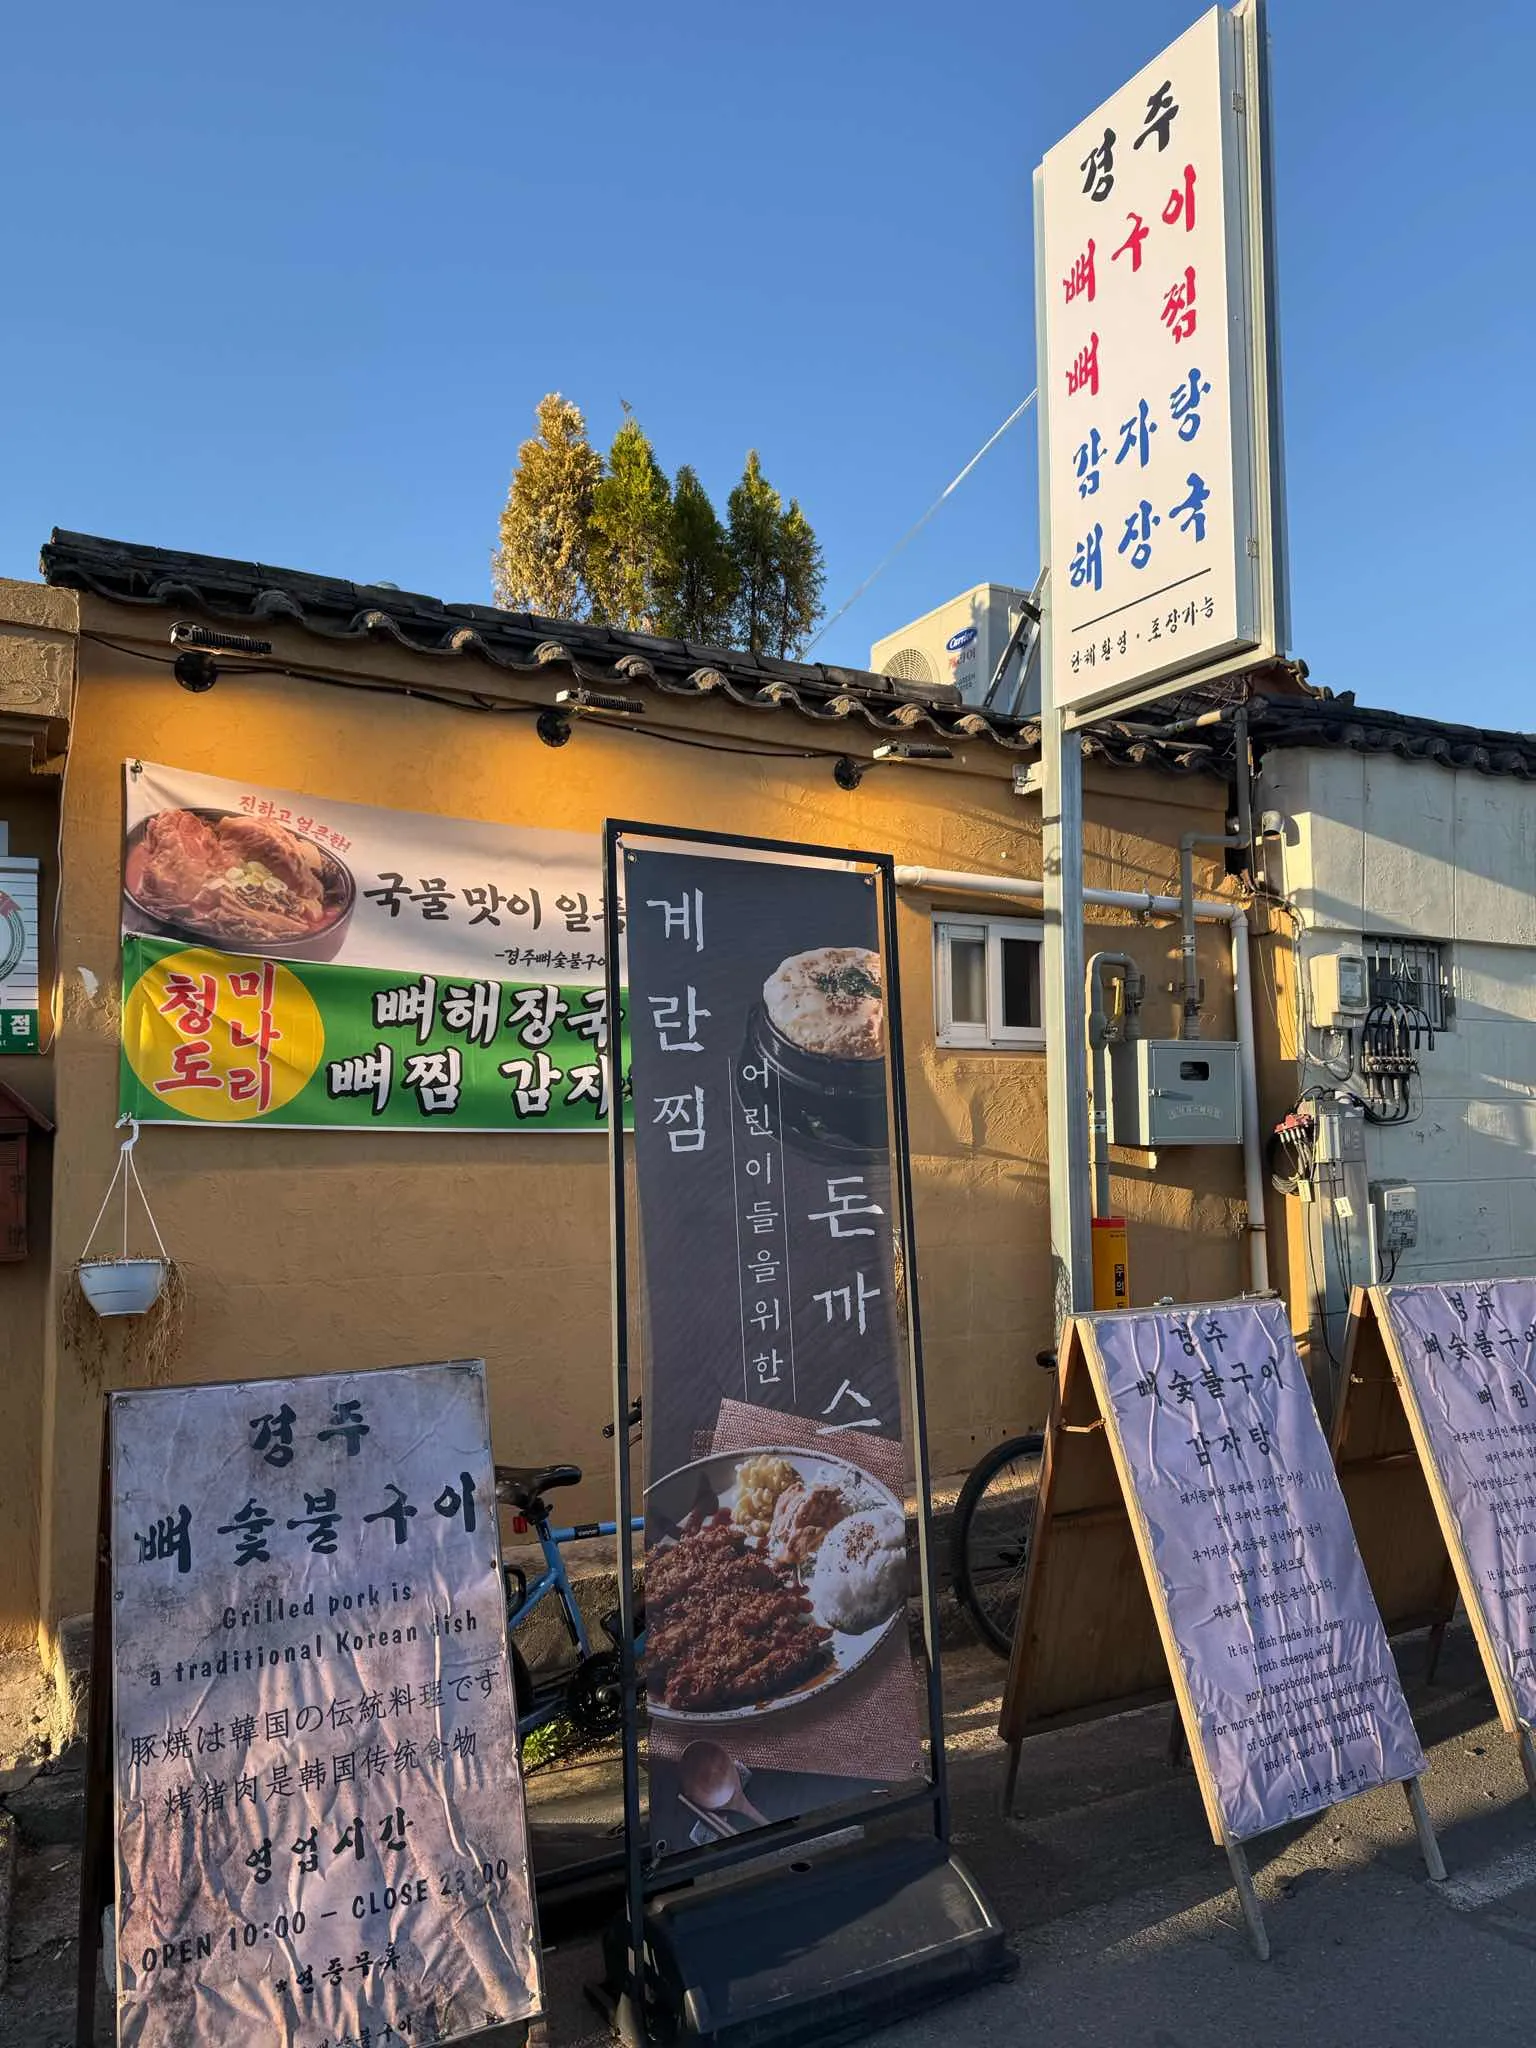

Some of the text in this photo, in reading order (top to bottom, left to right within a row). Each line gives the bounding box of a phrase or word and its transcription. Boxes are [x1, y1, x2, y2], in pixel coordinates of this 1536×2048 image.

[1081, 80, 1179, 202] 경주
[1063, 164, 1197, 305] 뼈구이
[1073, 368, 1211, 500] 감자탕
[1069, 473, 1211, 592] 해장국
[1071, 596, 1214, 673] 단체환영 포장가능
[239, 796, 292, 823] 진하고
[363, 872, 455, 920] 국물
[463, 884, 541, 930] 맛이
[153, 973, 224, 1094] 청도
[226, 961, 283, 1113] 미나리
[374, 975, 625, 1053] 뼈해장국
[647, 887, 711, 1153] 계란찜
[327, 1043, 632, 1121] 뼈찜 감자
[807, 1175, 884, 1436] 돈까스
[1170, 1320, 1229, 1357] 경주
[1450, 1290, 1495, 1322] 경주
[249, 1400, 370, 1468] 경주
[1185, 1422, 1271, 1467] 감자탕
[133, 1471, 476, 1574] 뼈숯불구이
[222, 1581, 411, 1630] Grilled pork is
[1258, 1634, 1277, 1651] dish
[1279, 1628, 1302, 1644] made
[1324, 1618, 1345, 1634] deep
[150, 1667, 161, 1687] a
[175, 1634, 321, 1682] traditional
[336, 1624, 418, 1653] Korean
[1280, 1651, 1314, 1669] steeped
[1315, 1641, 1335, 1658] with
[128, 1670, 501, 1770] 豚焼は韓国の伝統料理です
[1212, 1724, 1229, 1738] for
[1231, 1718, 1255, 1733] more
[1256, 1708, 1278, 1725] than
[1278, 1701, 1292, 1716] 12
[1294, 1696, 1320, 1712] hours
[1320, 1688, 1337, 1704] and
[1245, 1686, 1267, 1705] pork
[1259, 1732, 1283, 1748] outer
[1284, 1721, 1313, 1740] leaves
[1314, 1715, 1331, 1730] and
[164, 1726, 478, 1821] 烤猪肉是韩国传统食物
[1264, 1757, 1280, 1773] and
[1291, 1744, 1316, 1762] loved
[1330, 1732, 1345, 1747] the
[246, 1807, 414, 1885] 영업시간
[141, 1935, 213, 1973] OPEN
[228, 1910, 307, 1952] 10:00
[352, 1878, 429, 1920] CLOSE
